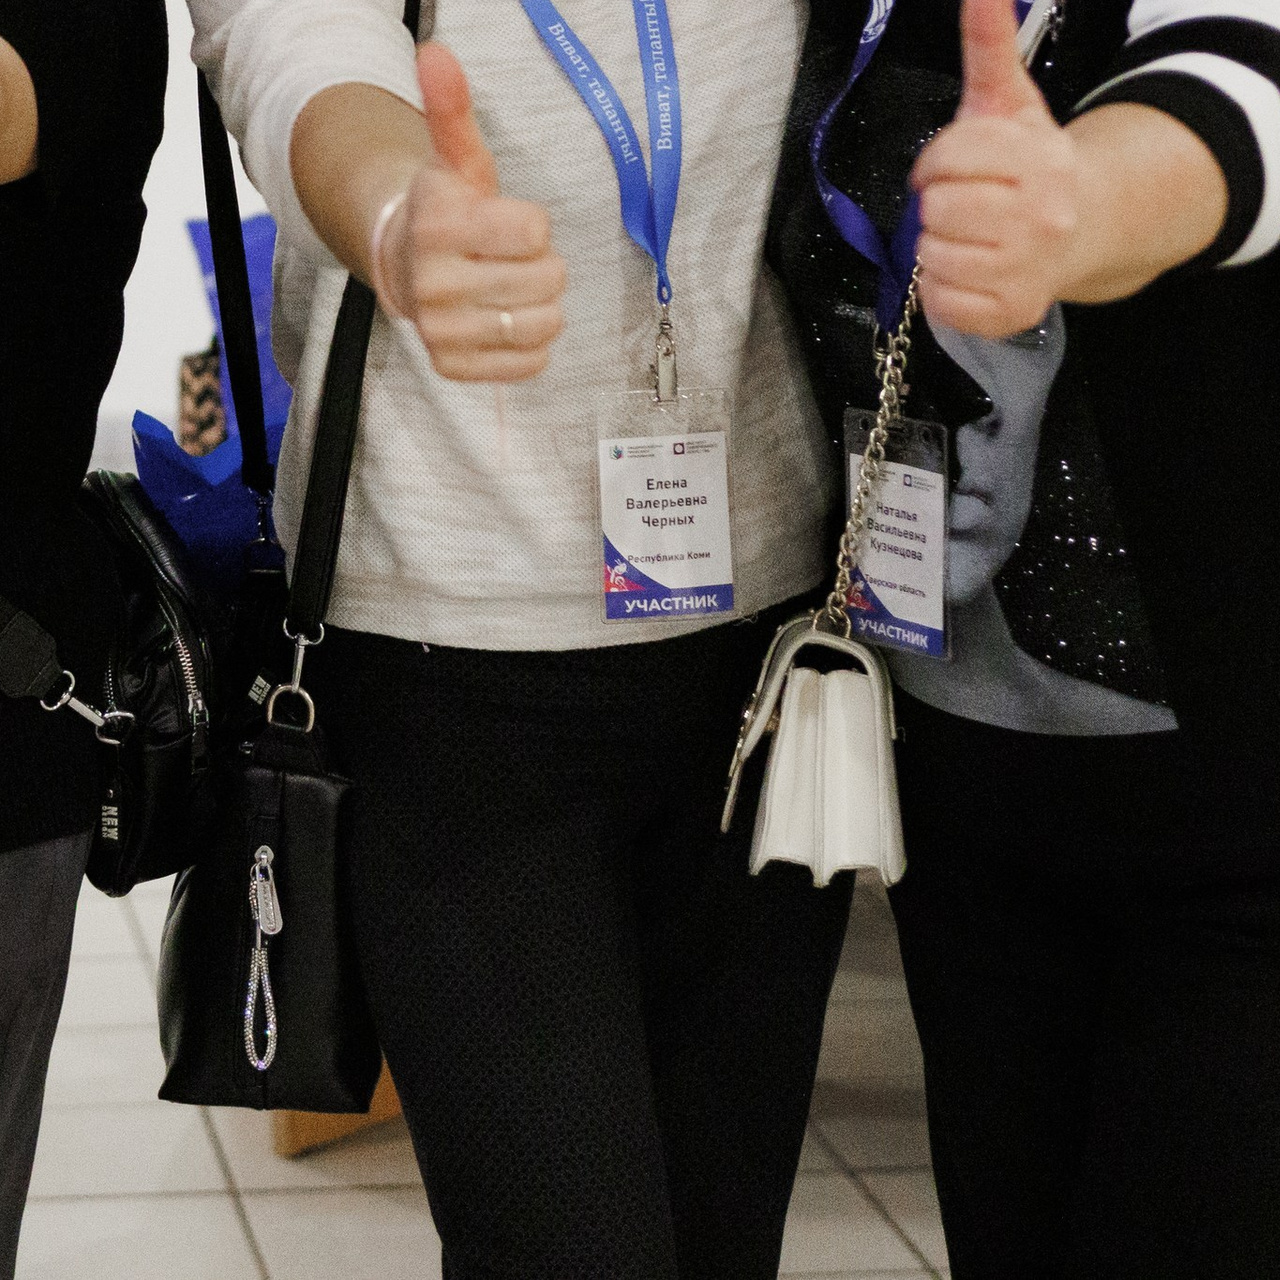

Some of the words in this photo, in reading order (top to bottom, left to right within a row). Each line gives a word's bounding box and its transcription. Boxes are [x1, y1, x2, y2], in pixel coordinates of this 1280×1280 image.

[547, 22, 591, 79] Виват,
[588, 77, 639, 164] таланты!
[657, 85, 673, 152] Виват,
[646, 478, 688, 491] Елена
[626, 495, 708, 511] Валерьевна
[875, 503, 918, 521] Наталья
[641, 515, 695, 530] Черных
[867, 517, 927, 544] Васильевна
[627, 554, 685, 565] Республика
[687, 551, 711, 560] Коми
[870, 537, 923, 562] Кузнецова
[624, 594, 719, 613] УЧАСТНИК
[858, 617, 929, 649] УЧАСТНИК
[107, 806, 119, 840] NEW
